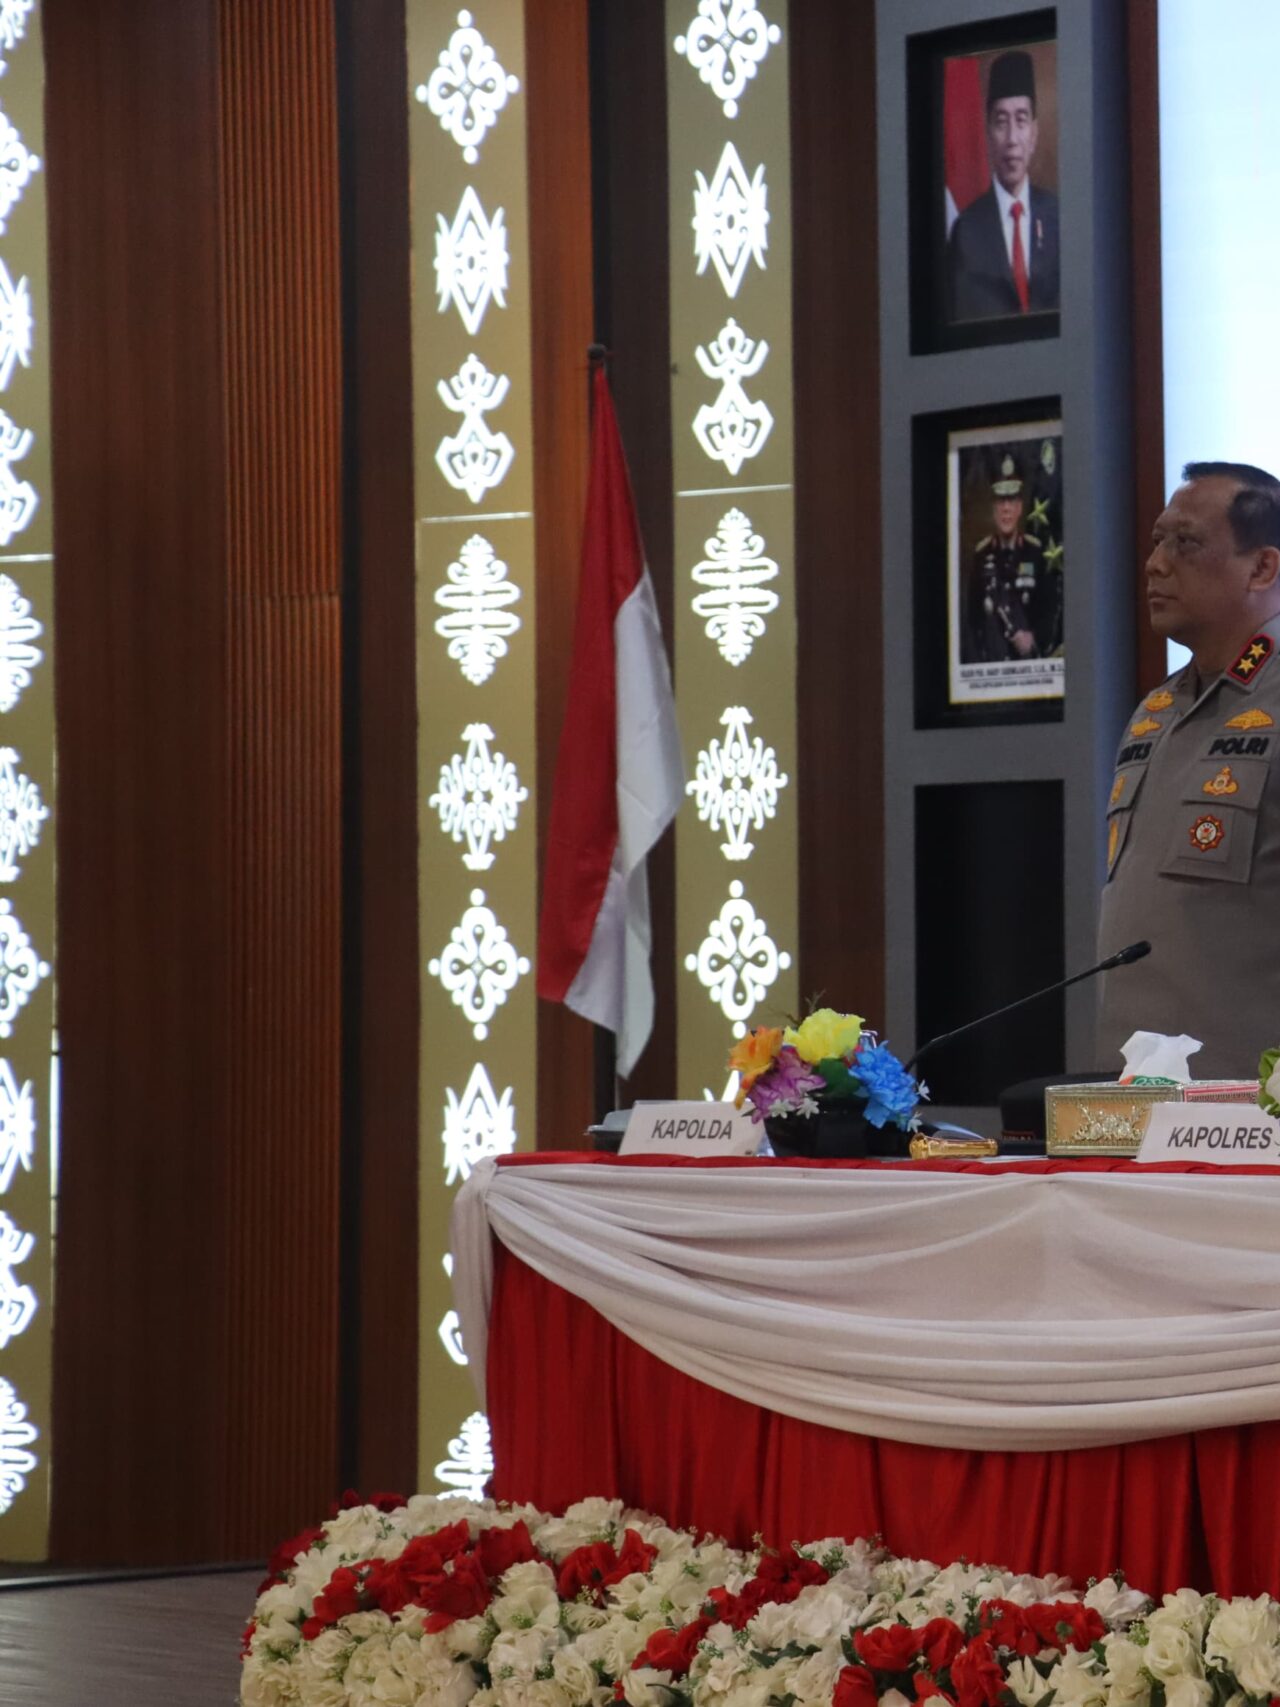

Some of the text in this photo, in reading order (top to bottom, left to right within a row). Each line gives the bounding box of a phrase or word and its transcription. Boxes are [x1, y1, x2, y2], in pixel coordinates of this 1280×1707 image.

[1208, 736, 1270, 756] POLRI
[651, 1119, 733, 1140] KAPOLDA
[1167, 1126, 1274, 1150] KAPOLRES
